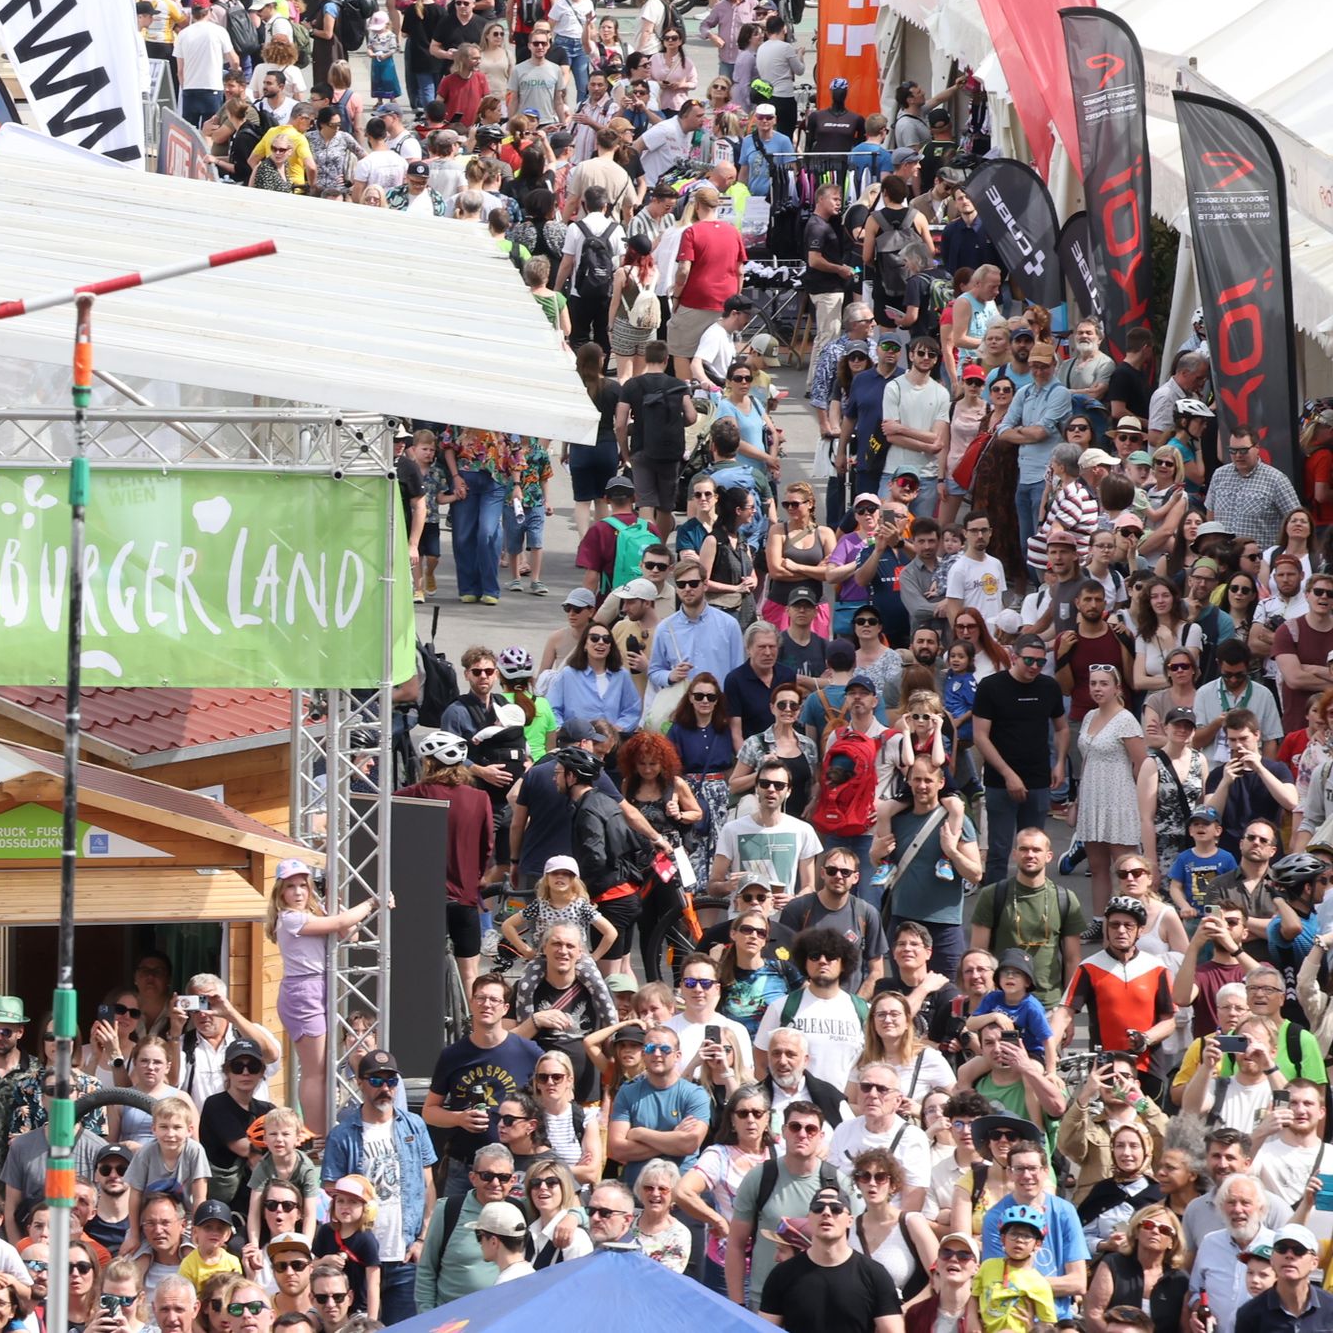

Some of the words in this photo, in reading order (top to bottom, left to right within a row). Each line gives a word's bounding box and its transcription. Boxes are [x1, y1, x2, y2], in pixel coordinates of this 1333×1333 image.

[228, 528, 365, 629] LAND
[37, 827, 64, 837] FUSC
[797, 1018, 858, 1037] PLEASURES
[486, 1064, 517, 1095] SPORTI
